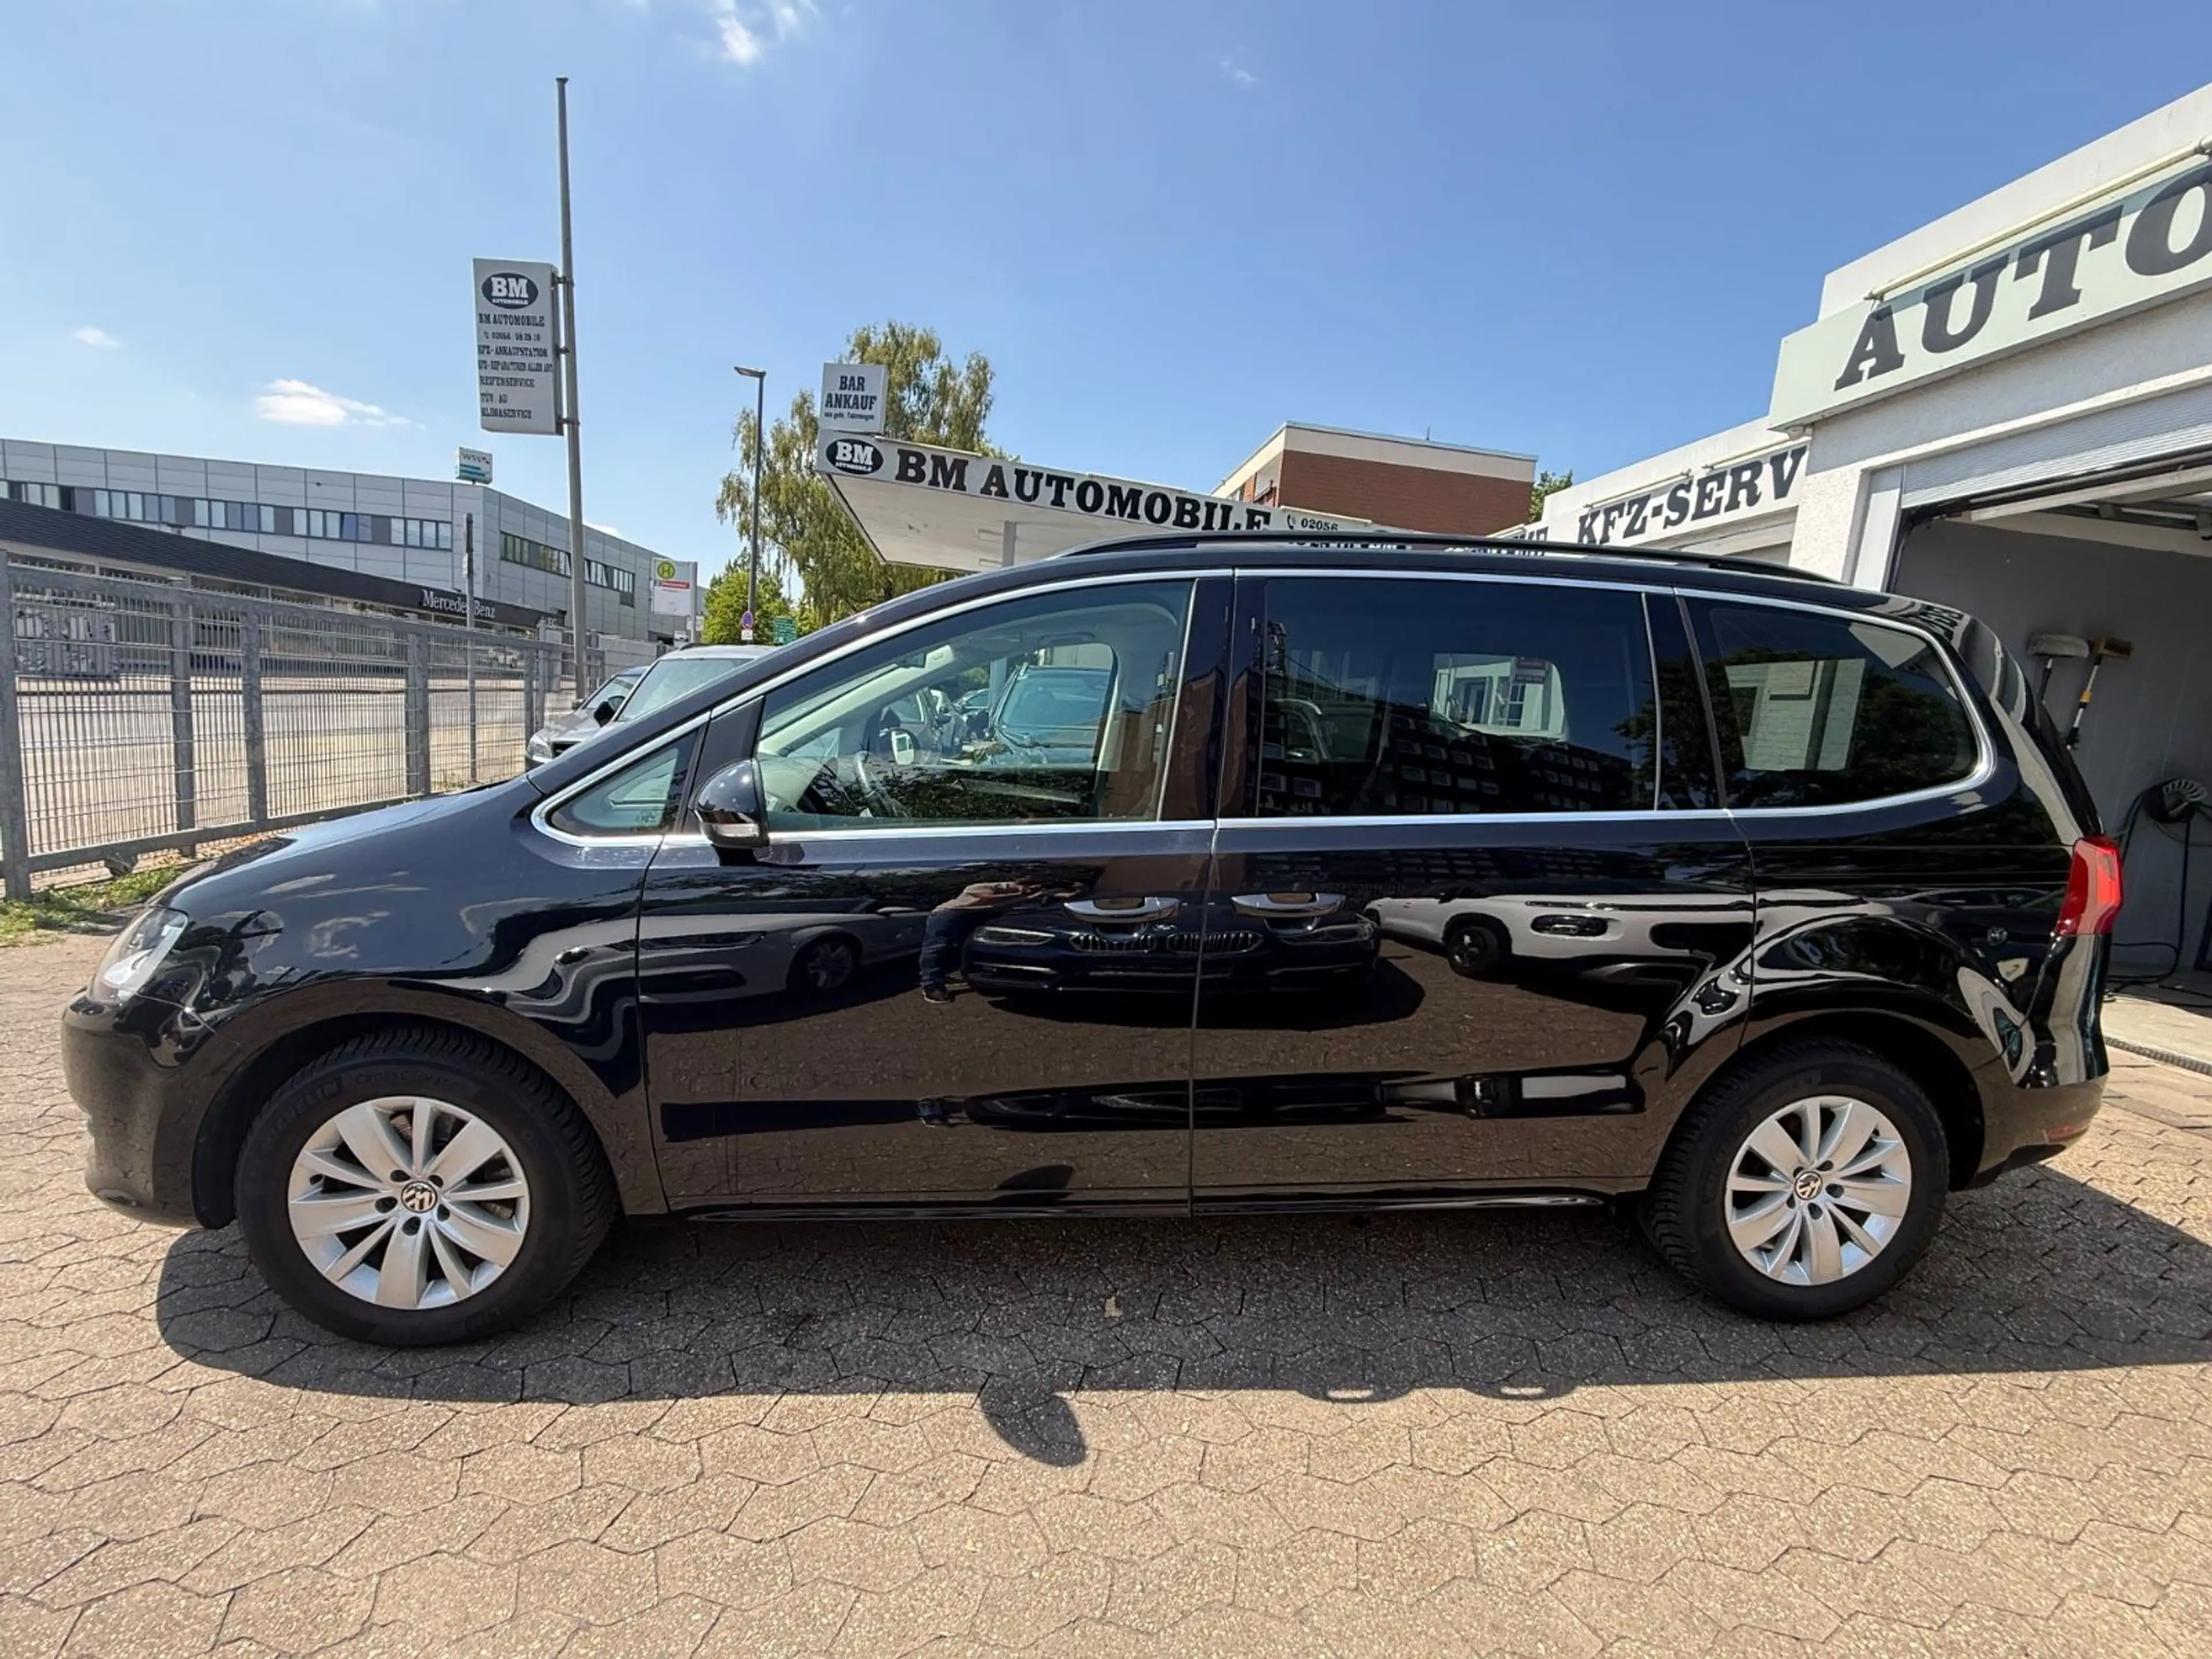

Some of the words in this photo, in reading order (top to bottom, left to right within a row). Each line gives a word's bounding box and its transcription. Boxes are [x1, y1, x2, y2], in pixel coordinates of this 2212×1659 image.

[491, 276, 528, 298] BM
[1834, 161, 2212, 391] AUTO
[479, 313, 491, 324] BM
[493, 314, 545, 327] AUTOMOBILE
[839, 376, 865, 392] BAR
[825, 393, 877, 410] ANKAUF
[836, 441, 873, 465] BM
[895, 449, 968, 491] BM
[980, 465, 1271, 530] AUTOMOBILE
